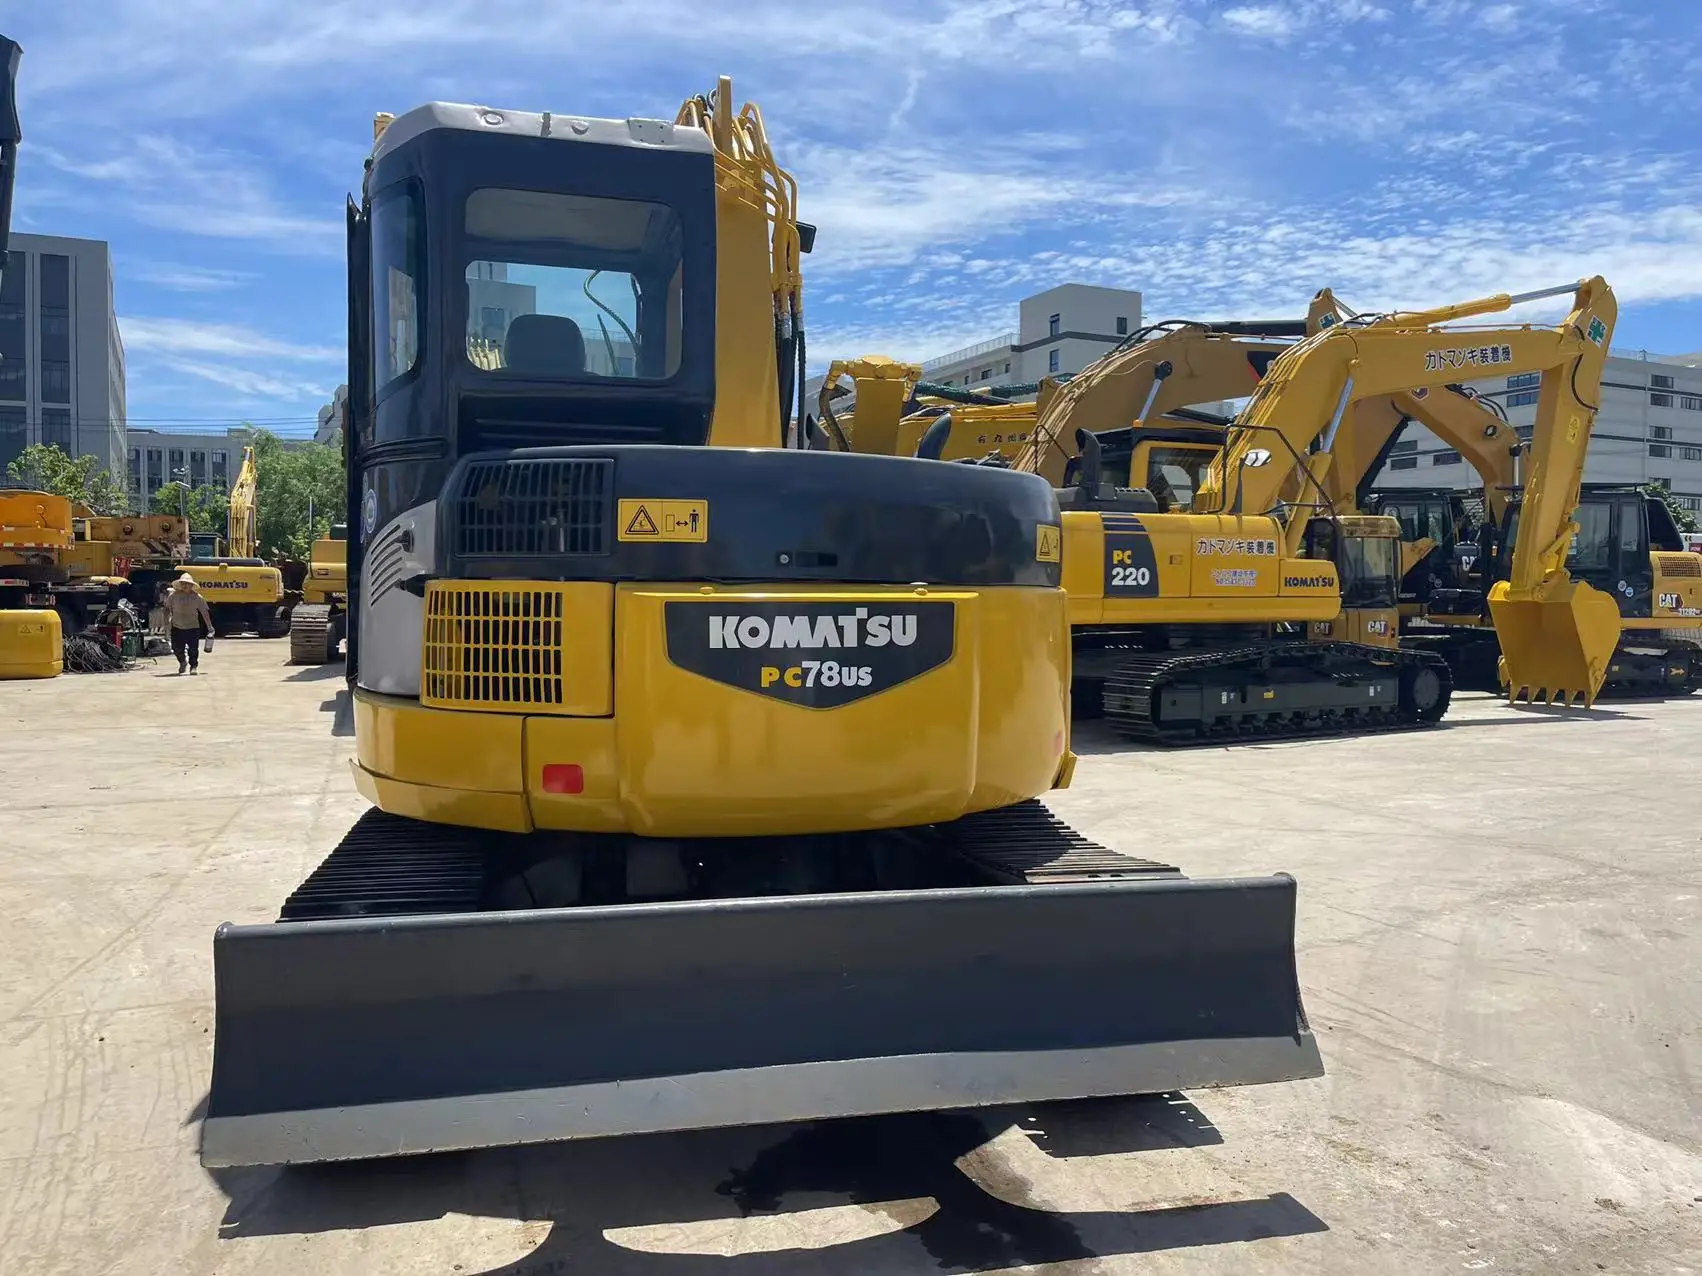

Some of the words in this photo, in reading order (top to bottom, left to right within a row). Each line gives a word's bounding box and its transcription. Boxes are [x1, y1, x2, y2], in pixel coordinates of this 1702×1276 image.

[1112, 550, 1132, 564] PC
[1111, 567, 1150, 586] 220
[1284, 575, 1335, 588] KOMATSU
[199, 580, 249, 589] KOMATSU
[1658, 593, 1678, 608] CAT
[709, 607, 918, 649] KOMATSU
[1314, 622, 1331, 634] CAT
[1367, 620, 1387, 633] CAT
[760, 660, 873, 688] PC78US
